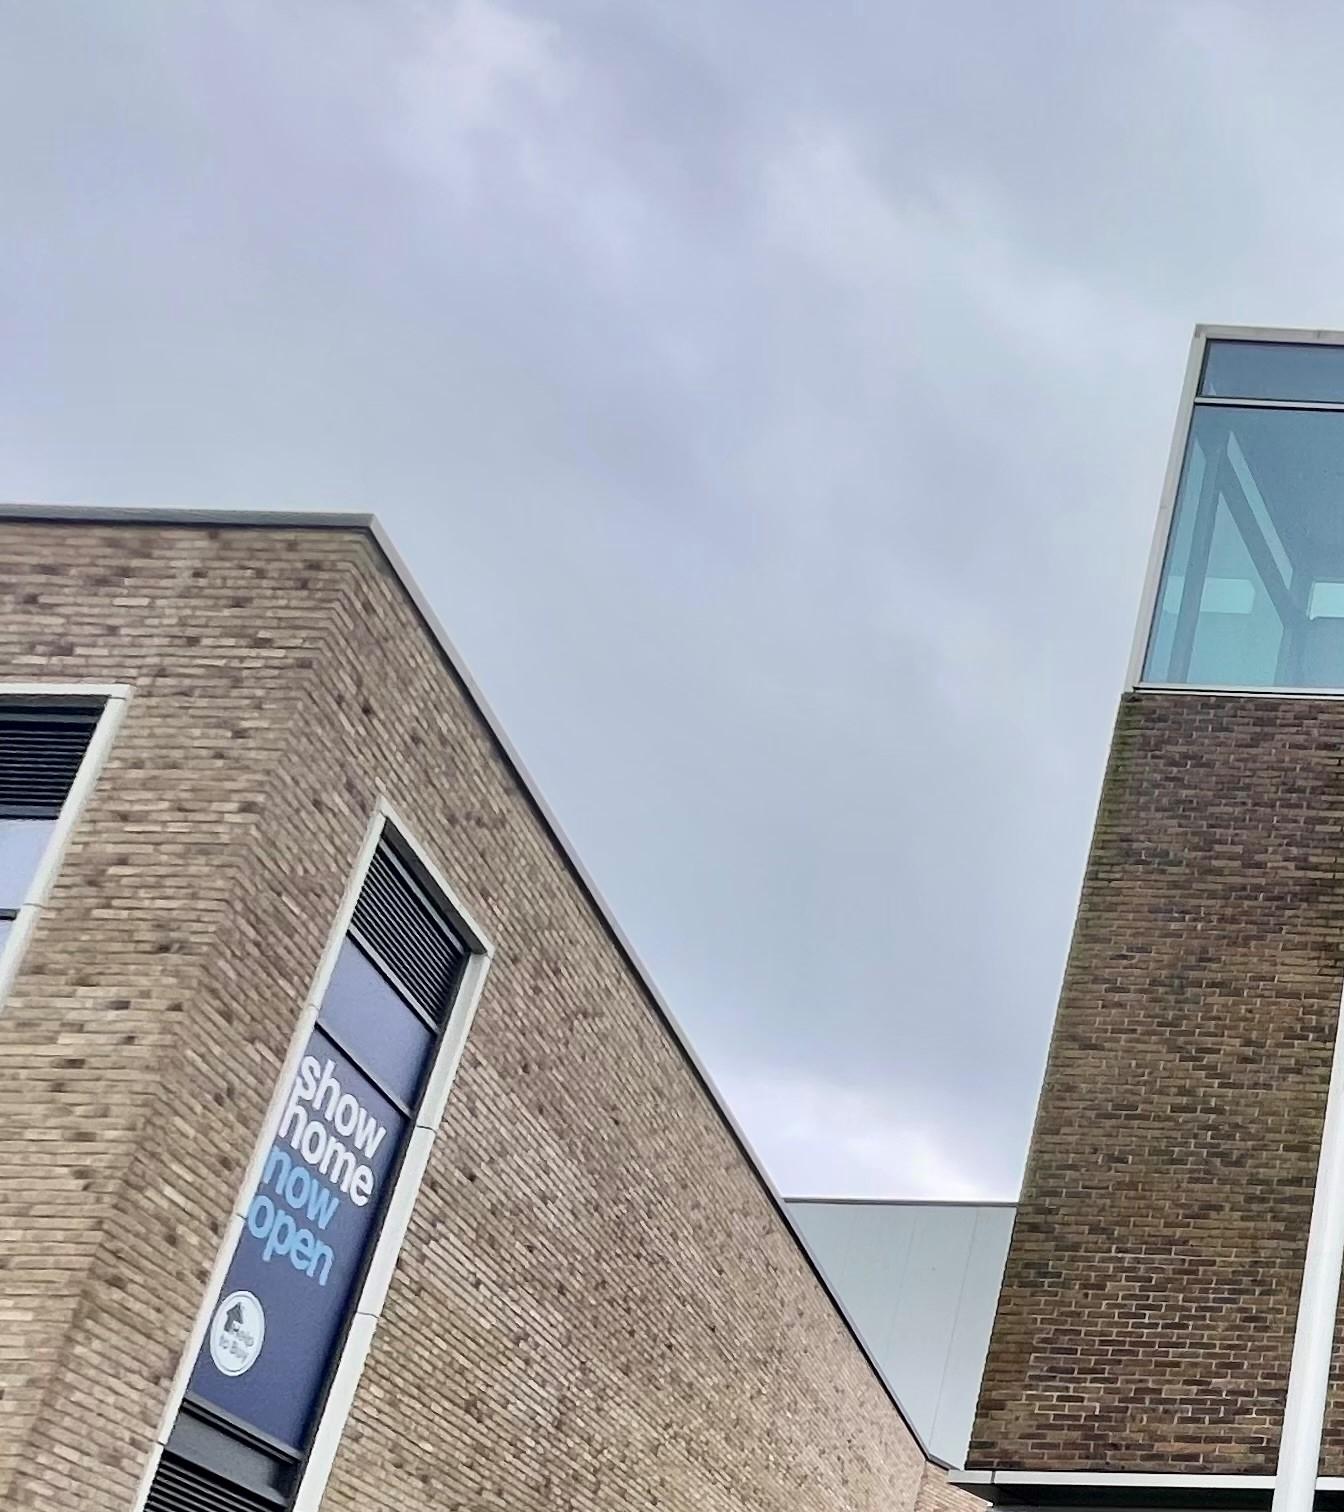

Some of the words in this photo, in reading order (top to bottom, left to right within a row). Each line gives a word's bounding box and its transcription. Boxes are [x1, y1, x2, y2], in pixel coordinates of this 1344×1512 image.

[279, 1076, 374, 1207] home
[299, 1055, 386, 1159] show
[263, 1145, 340, 1230] now
[248, 1195, 335, 1286] open
